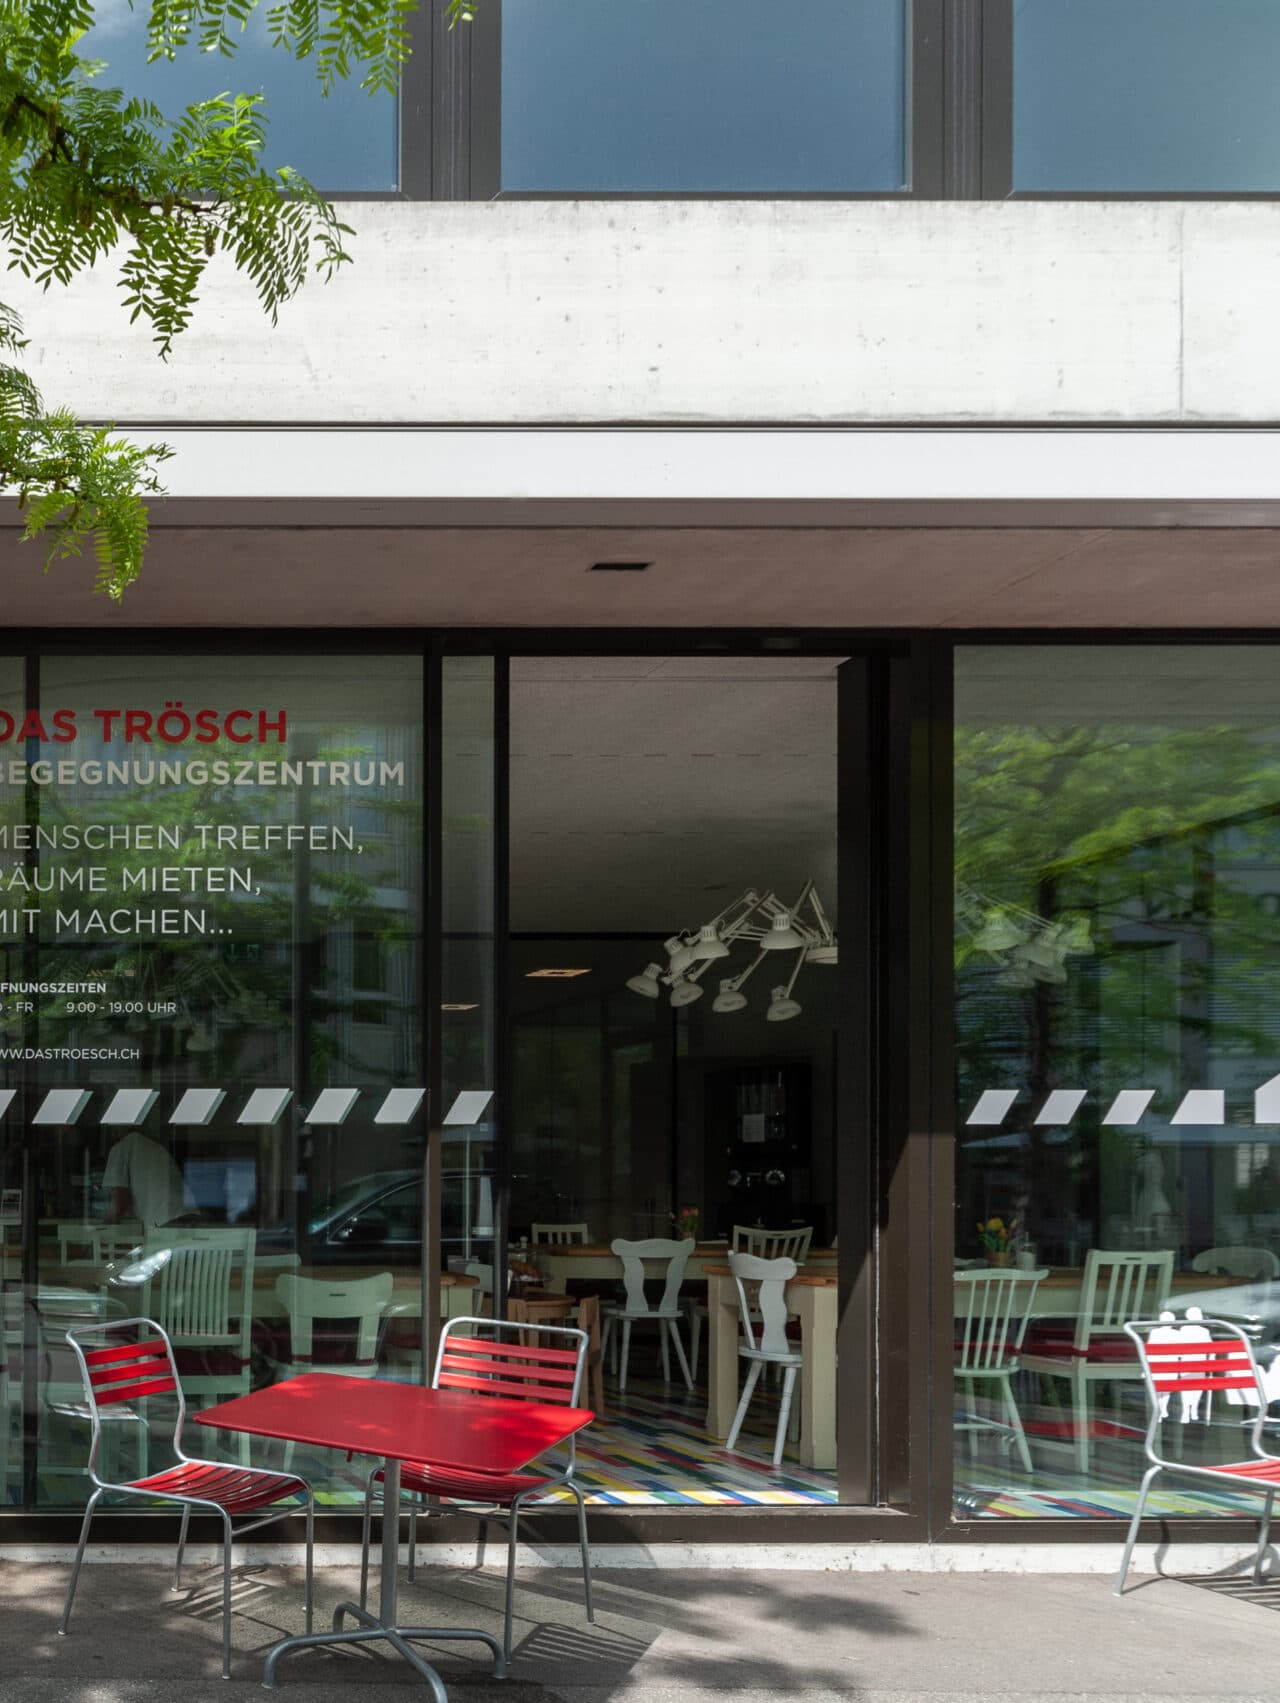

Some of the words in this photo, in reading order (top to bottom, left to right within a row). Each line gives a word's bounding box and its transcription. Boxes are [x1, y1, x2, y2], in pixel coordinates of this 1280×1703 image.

[94, 702, 288, 744] TRÖSCH
[190, 824, 364, 854] TREFFEN,
[122, 866, 262, 897] MIETEN,
[55, 908, 233, 935] MACHEN...
[16, 1001, 34, 1014] FR
[66, 1001, 96, 1014] 9.00
[109, 1001, 144, 1014] 19.00
[147, 1001, 177, 1014] UHR
